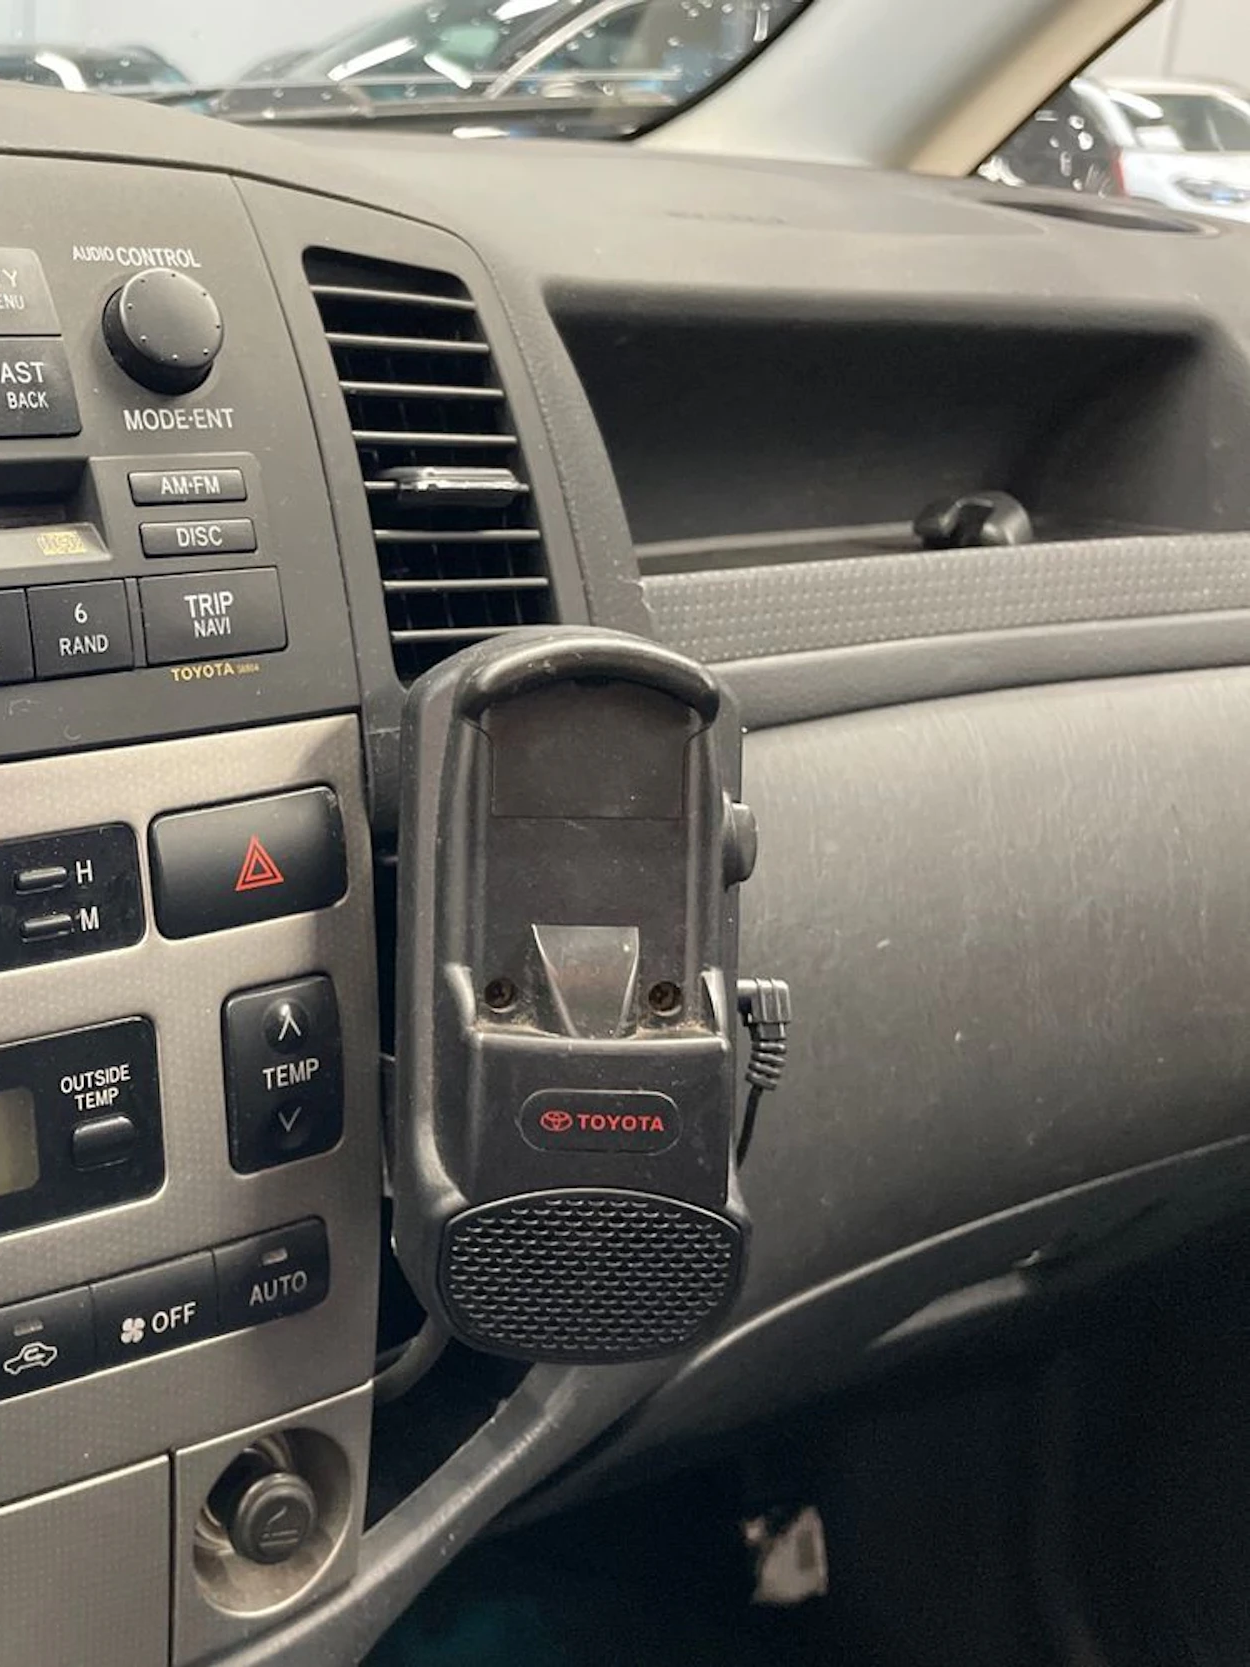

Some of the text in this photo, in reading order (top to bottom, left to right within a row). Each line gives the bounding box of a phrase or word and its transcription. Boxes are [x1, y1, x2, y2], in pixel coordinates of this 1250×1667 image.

[72, 245, 202, 268] AUDIO CONTROL
[0, 361, 45, 384] AST
[5, 390, 49, 410] BACK
[175, 524, 223, 547] DISC
[73, 602, 88, 624] 6
[184, 591, 234, 618] TRIP
[193, 617, 232, 638] NAVI
[58, 634, 109, 656] RAND
[170, 662, 235, 682] TOYOTA
[75, 860, 94, 884] H
[79, 907, 100, 933] M
[60, 1063, 131, 1094] OUTSIDE
[262, 1057, 320, 1090] TEMP
[74, 1087, 120, 1112] TEMP
[577, 1114, 665, 1133] TOYOTA
[249, 1270, 308, 1307] AUTO
[151, 1302, 197, 1334] OFF
